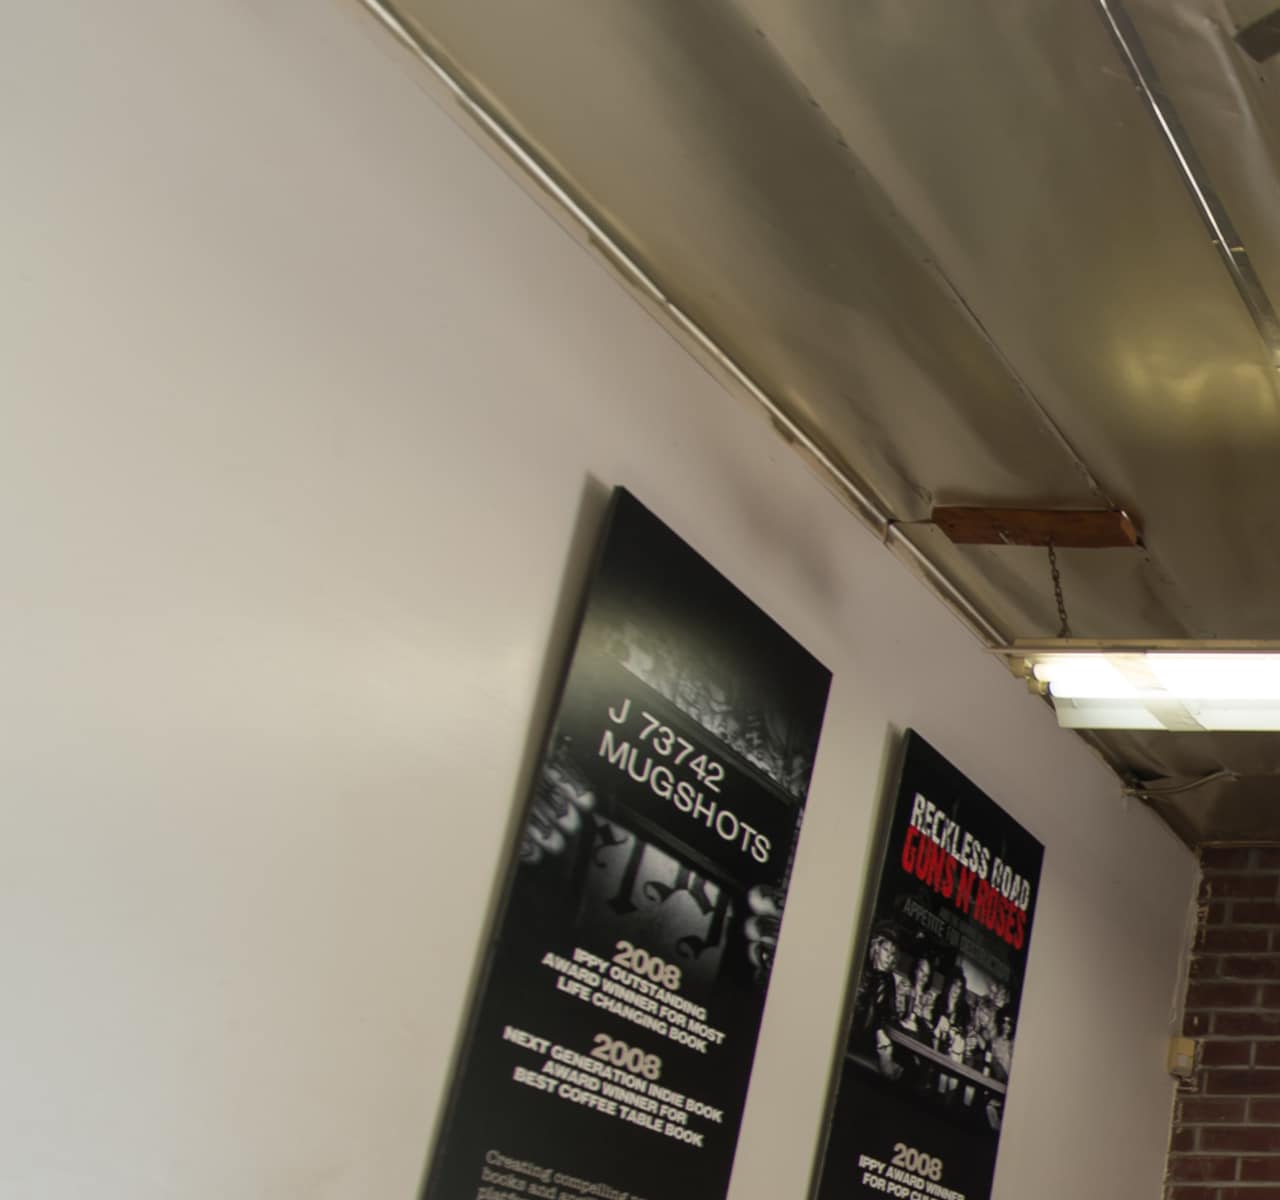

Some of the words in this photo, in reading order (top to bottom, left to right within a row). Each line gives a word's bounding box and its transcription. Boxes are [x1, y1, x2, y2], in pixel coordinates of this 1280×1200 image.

[608, 699, 631, 724] J
[639, 711, 725, 793] 73742
[598, 730, 771, 863] MUGSHOTS
[902, 825, 957, 898] GUNS
[973, 879, 1027, 950] ROSES
[910, 792, 990, 880] RECKLESS
[991, 856, 1031, 912] ROAD
[541, 952, 601, 987] AWARD
[601, 978, 658, 1014] WINNER
[659, 1006, 687, 1028] FOR
[687, 1018, 726, 1045] MOST
[573, 947, 610, 973] IPPY
[609, 966, 707, 1021] OUTSTANDING
[612, 940, 681, 990] 2008
[556, 976, 592, 1001] LIFE
[592, 992, 668, 1035] CHANGING
[668, 1027, 708, 1053] BOOK
[503, 1025, 550, 1054] NEXT
[550, 1045, 647, 1093] GENERATION
[647, 1080, 685, 1108] INDIE
[685, 1098, 724, 1124] BOOK
[542, 1060, 600, 1091] AWARD
[601, 1082, 658, 1114] WINNER
[659, 1105, 688, 1125] FOR
[590, 1033, 662, 1080] 2008
[512, 1066, 558, 1093] BEST
[558, 1083, 617, 1116] COFFEE
[619, 1105, 664, 1133] TABLE
[664, 1125, 705, 1148] BOOK
[481, 1166, 526, 1191] books
[527, 1182, 557, 1200] and
[485, 1150, 553, 1183] Creating
[858, 1154, 886, 1174] IPPY
[885, 1166, 925, 1190] AWARD
[862, 1172, 886, 1192] FOR
[886, 1181, 910, 1199] POP
[891, 1142, 943, 1181] 2008
